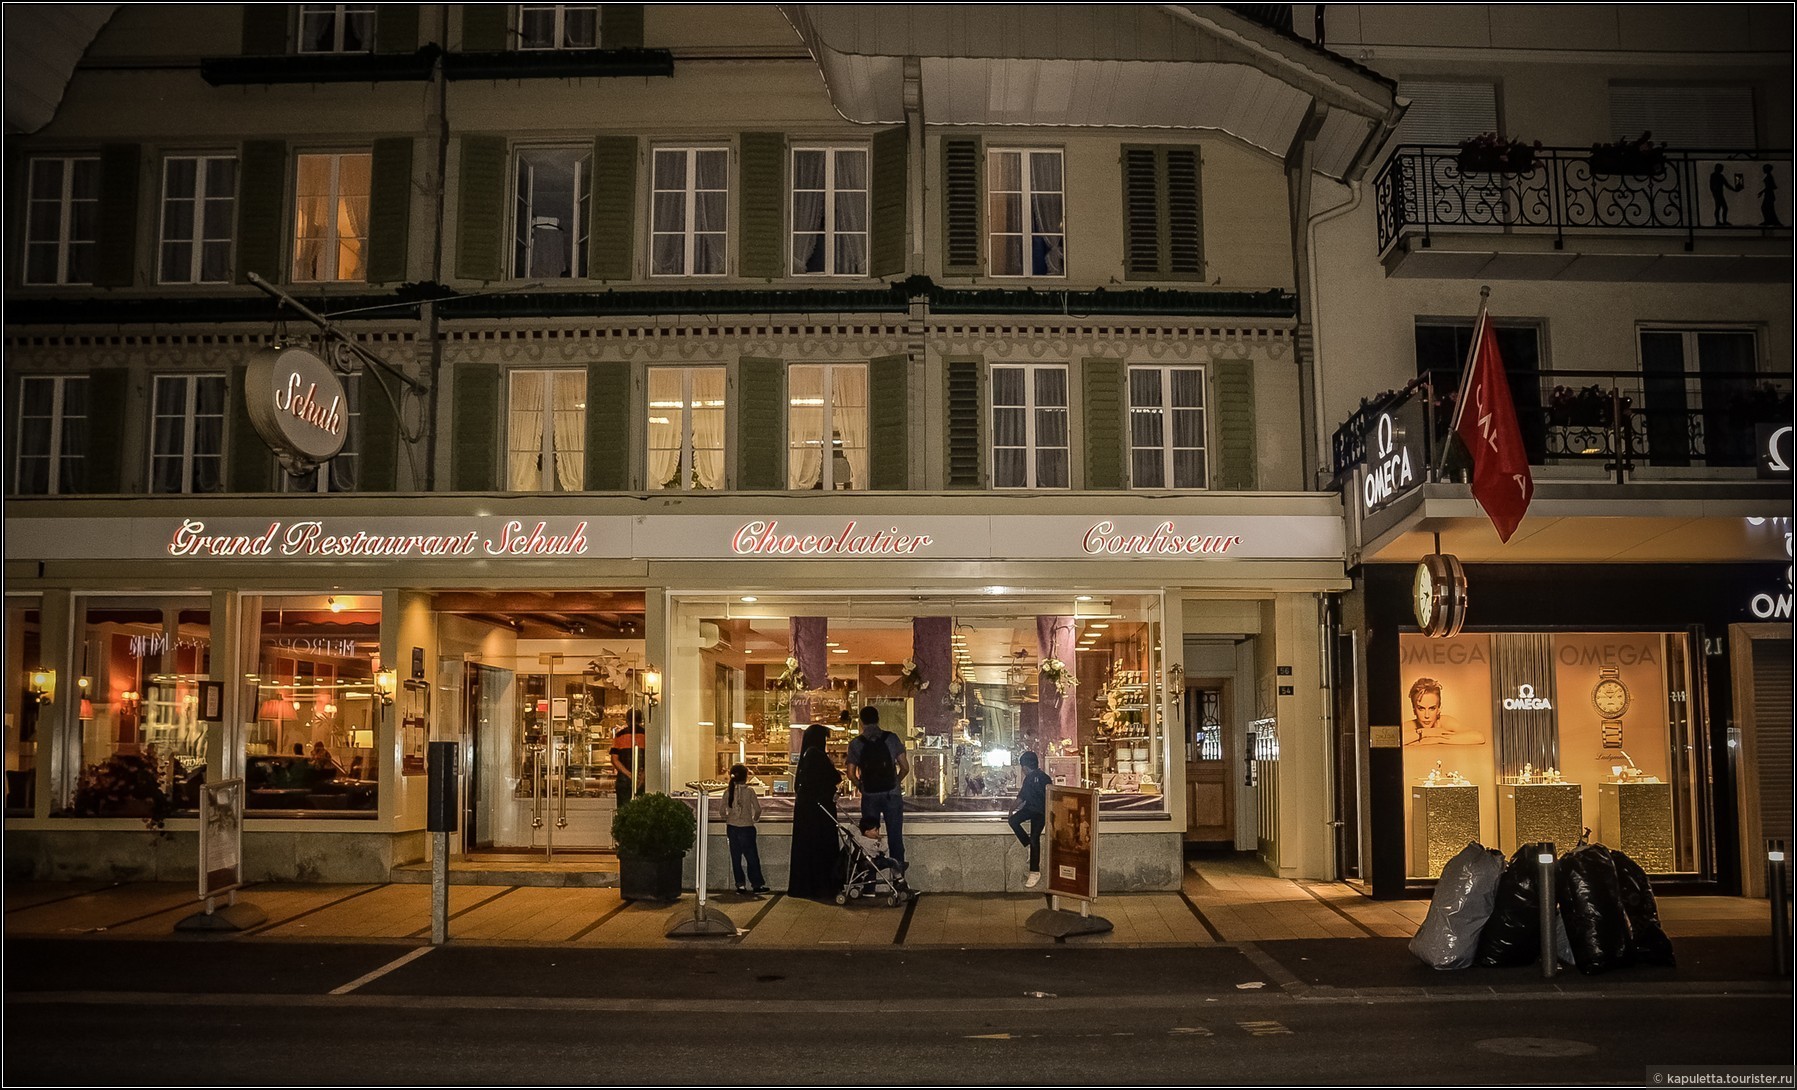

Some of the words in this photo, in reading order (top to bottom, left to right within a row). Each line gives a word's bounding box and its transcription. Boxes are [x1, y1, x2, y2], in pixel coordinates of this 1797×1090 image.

[275, 372, 341, 436] Schuh
[167, 518, 281, 556] Grand
[279, 520, 479, 556] Restaurant
[483, 520, 589, 556] Schuh
[731, 520, 934, 555] Chocolatier
[1081, 520, 1244, 555] Confiseur
[1279, 667, 1290, 675] 56
[1559, 644, 1657, 666] OMEGA
[1503, 697, 1552, 711] OMEGA
